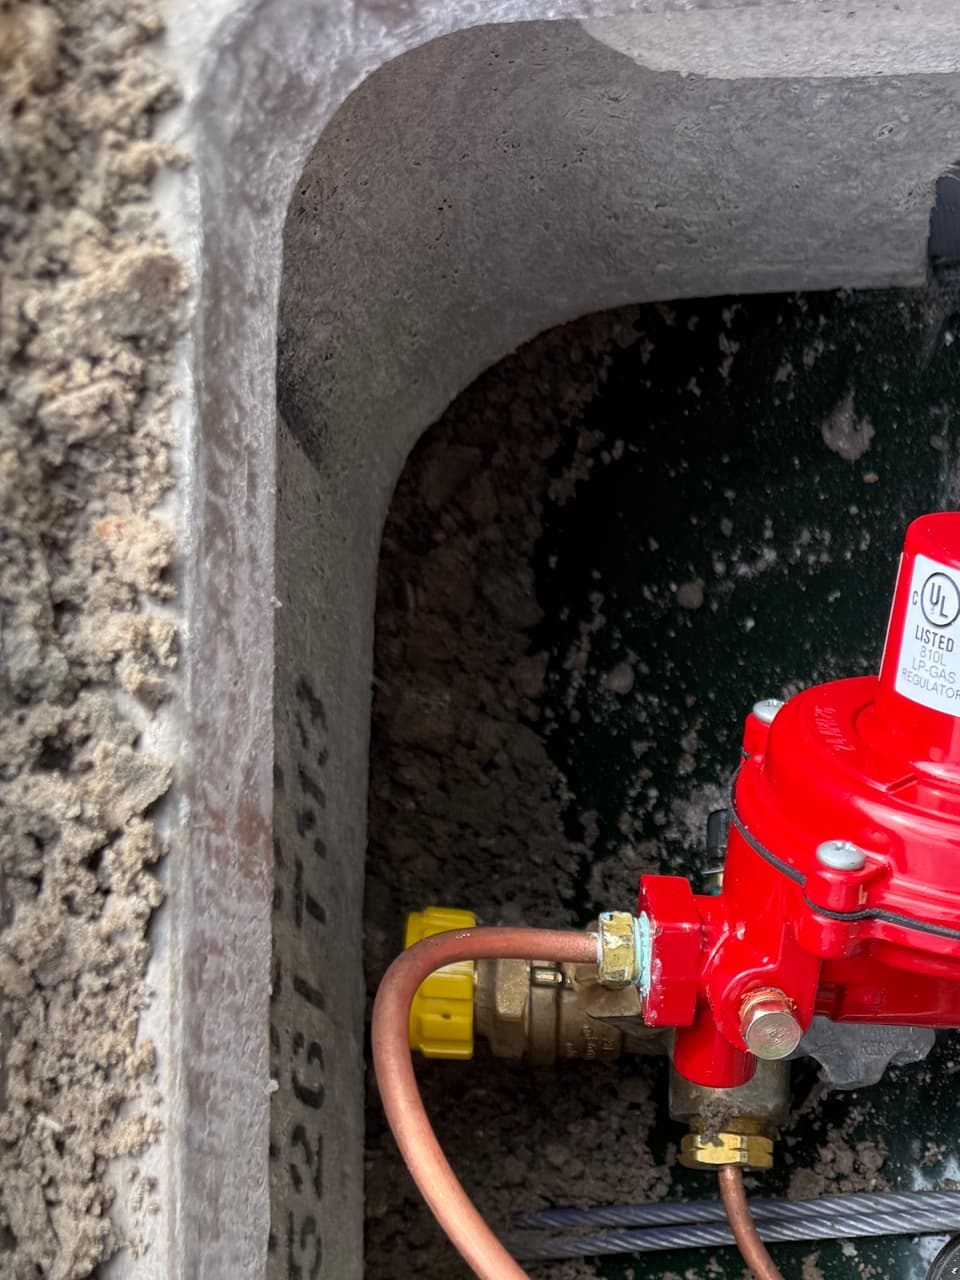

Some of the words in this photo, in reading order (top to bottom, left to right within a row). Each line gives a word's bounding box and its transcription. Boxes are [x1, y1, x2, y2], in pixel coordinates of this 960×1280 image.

[929, 582, 949, 619] UL
[915, 624, 955, 653] LISTED
[912, 656, 957, 685] LP-GAS
[920, 645, 946, 667] 810L
